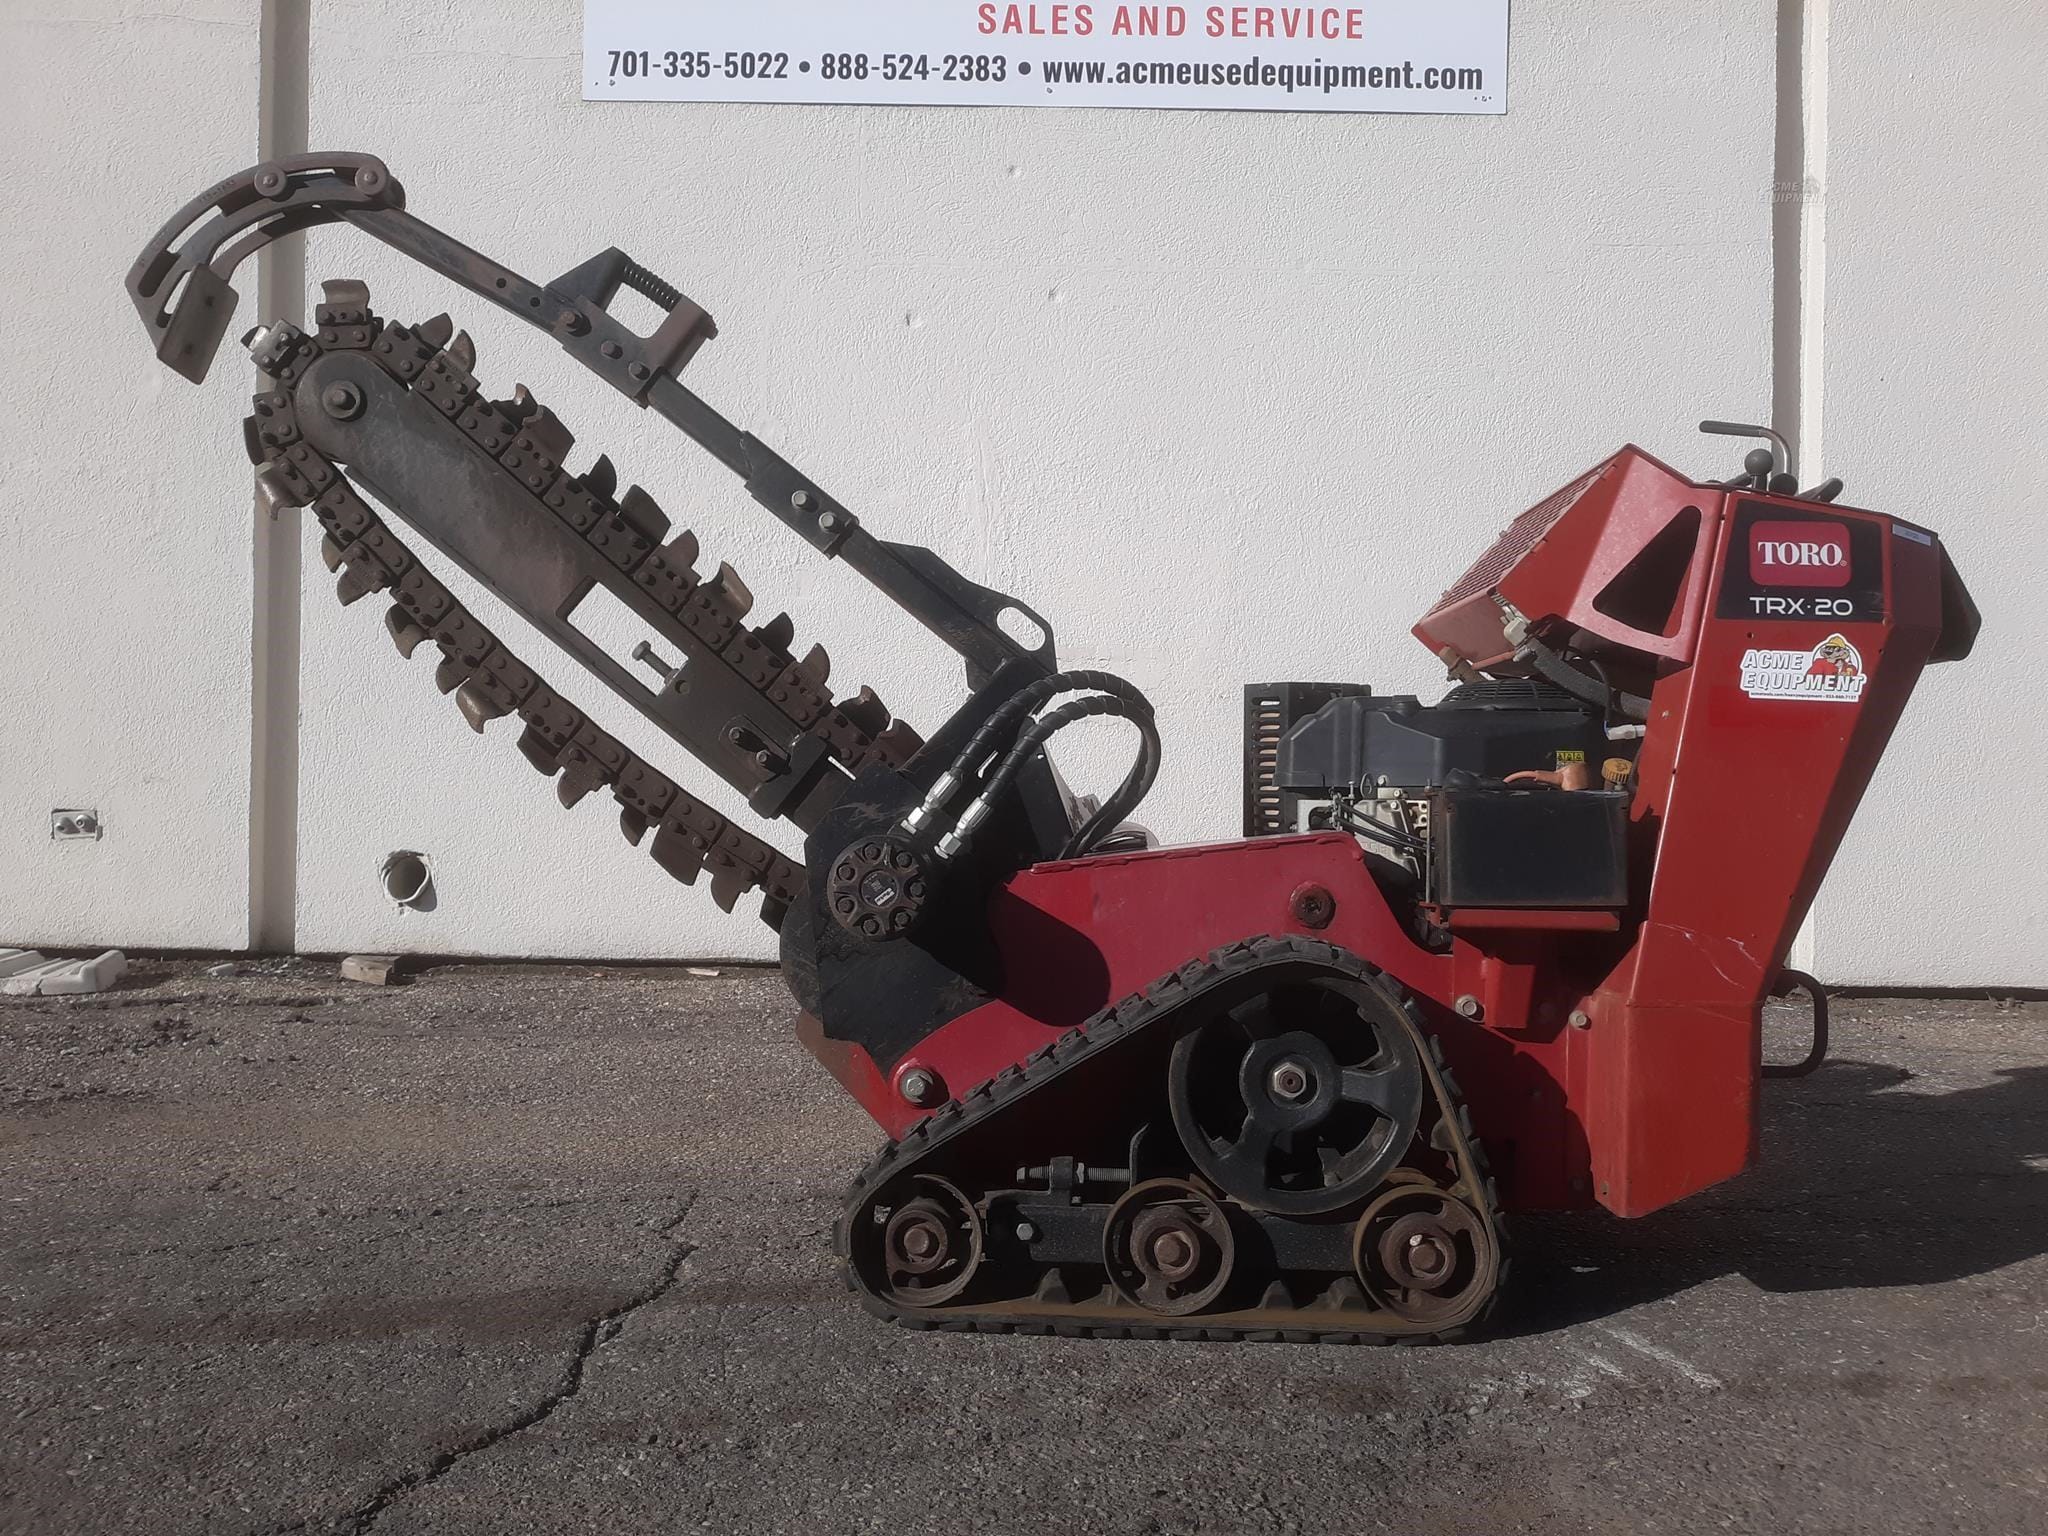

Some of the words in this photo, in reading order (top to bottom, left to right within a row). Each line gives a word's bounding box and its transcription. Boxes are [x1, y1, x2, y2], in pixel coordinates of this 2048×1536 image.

[978, 3, 1094, 36] SALES
[1111, 6, 1187, 37] AND
[1206, 6, 1364, 40] SERVICE
[607, 50, 790, 80] 701-335-5022
[820, 52, 1008, 82] 888-524-2383
[1042, 55, 1484, 94] www.acmeusedequipment.com
[1757, 541, 1844, 567] TORO
[1743, 651, 1804, 670] ACME
[1743, 671, 1865, 692] EQUIPMENT
